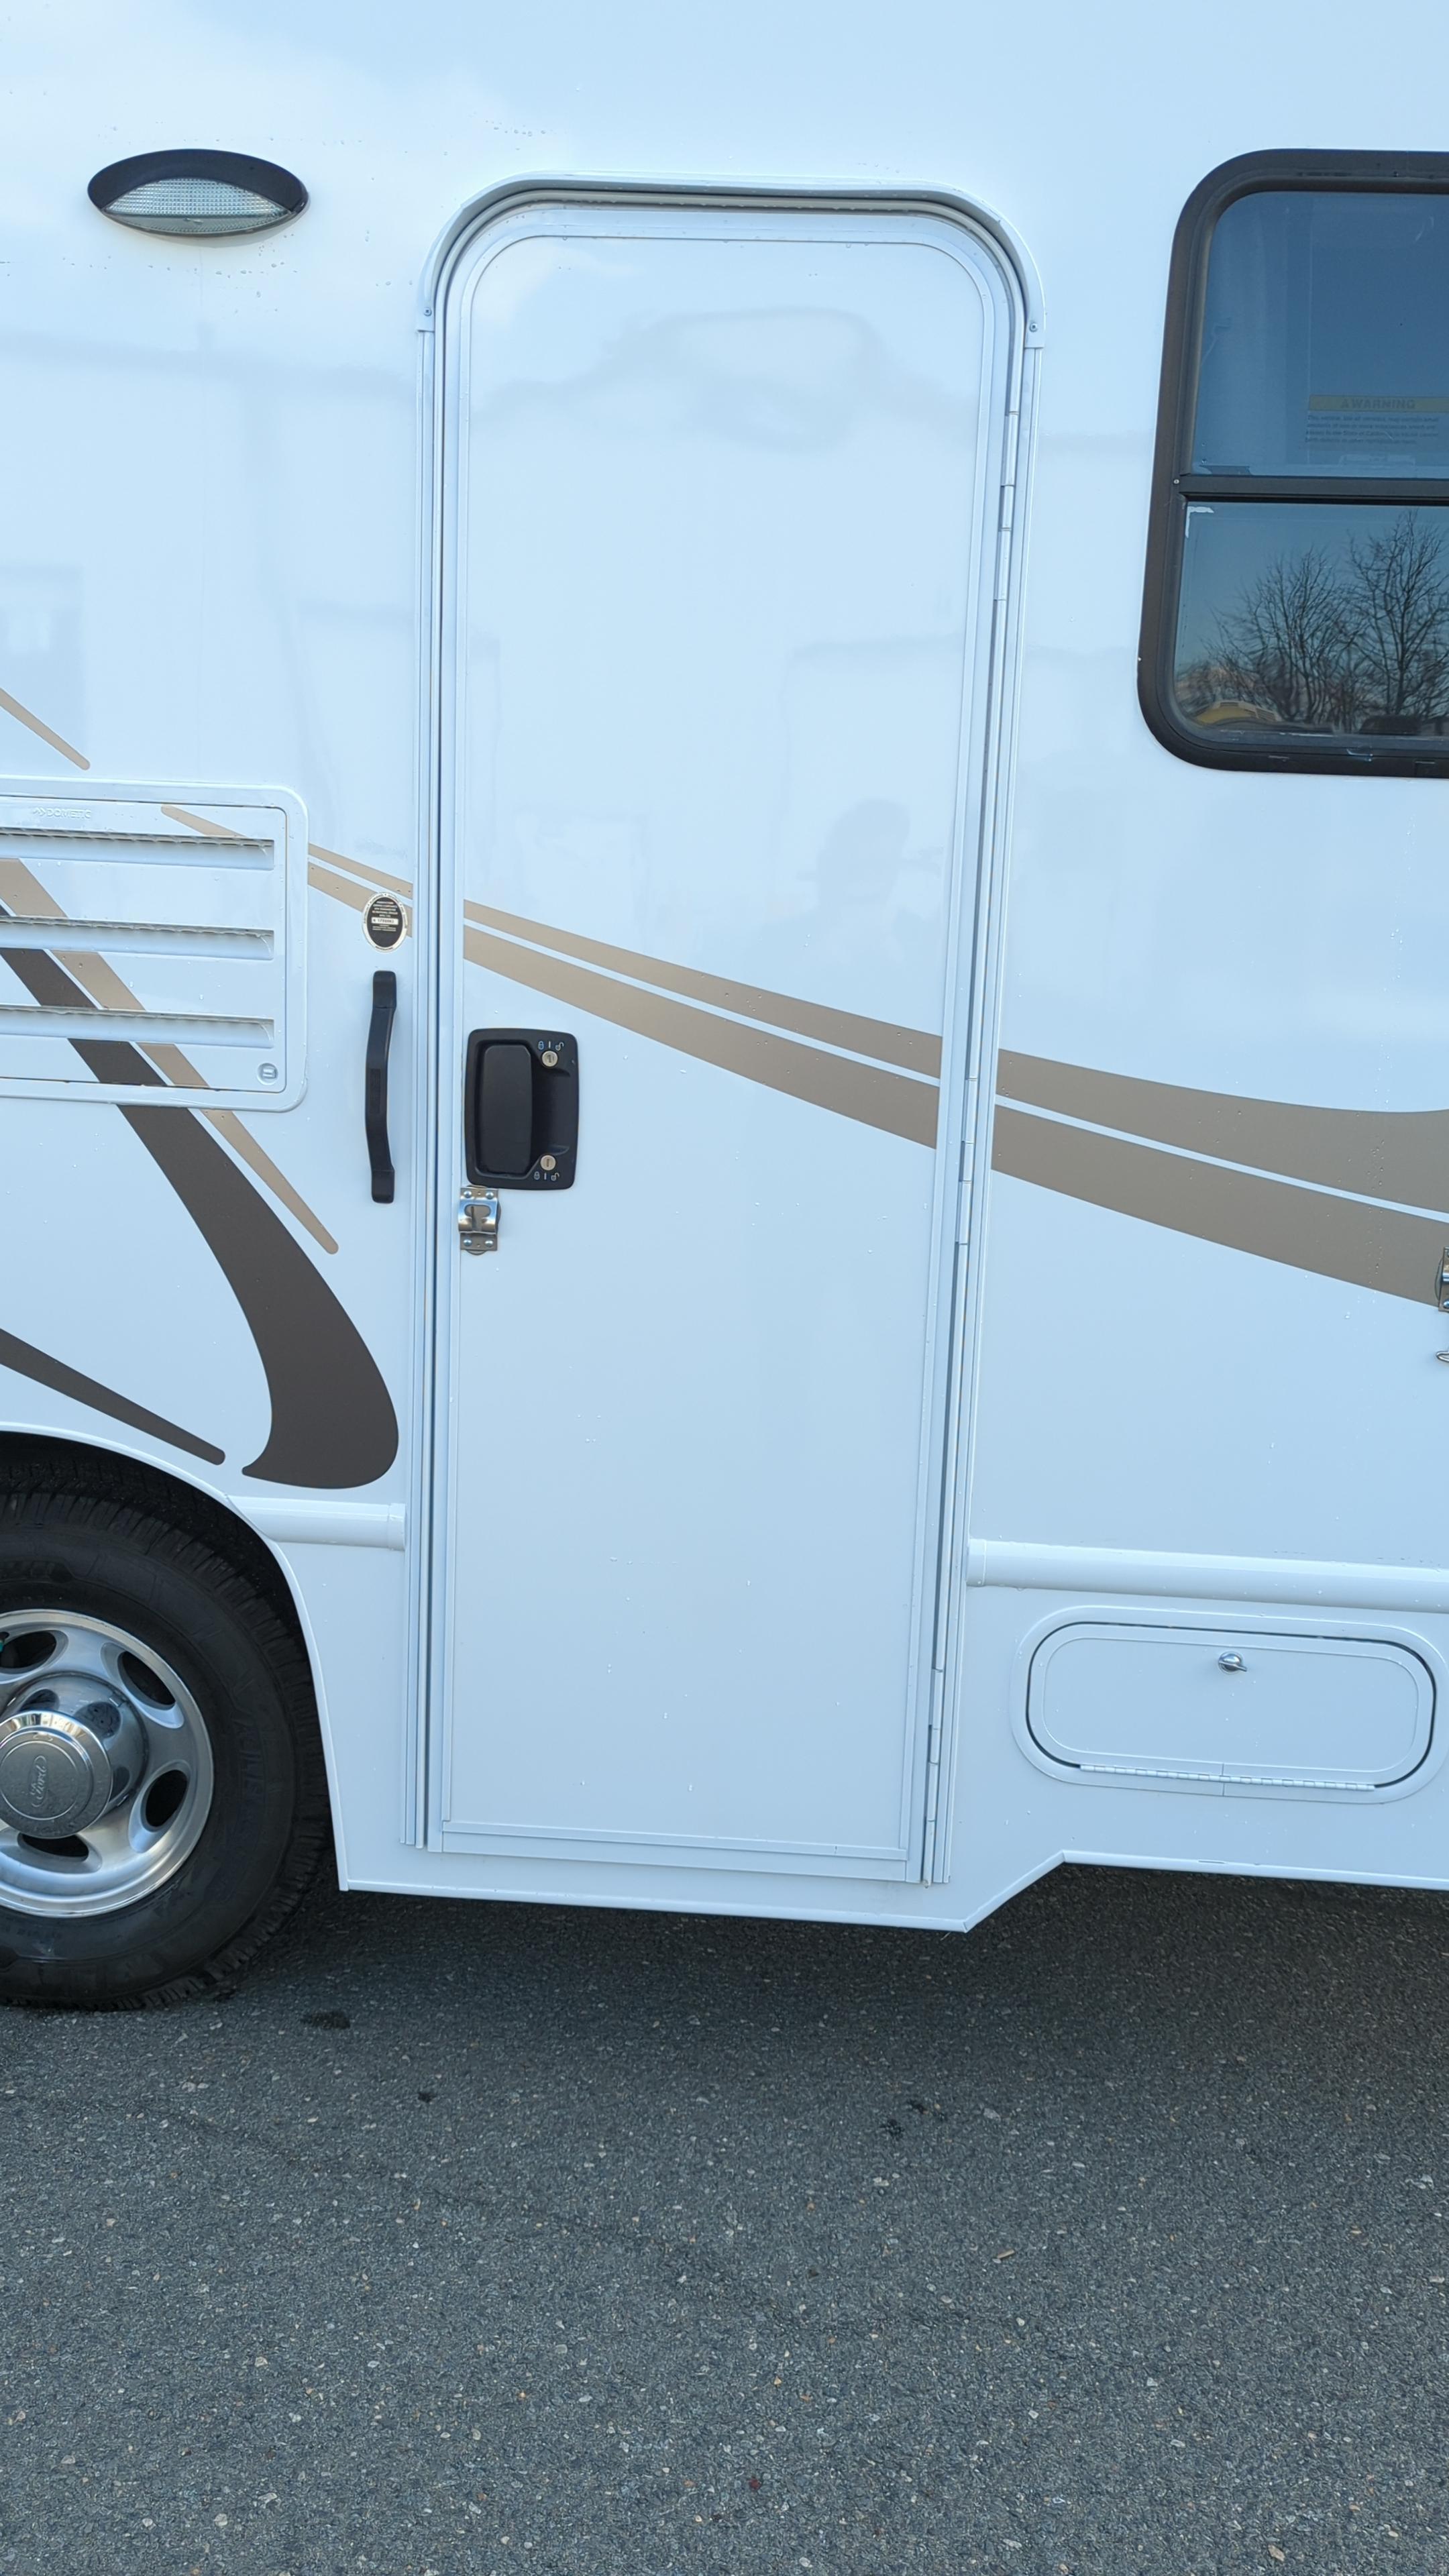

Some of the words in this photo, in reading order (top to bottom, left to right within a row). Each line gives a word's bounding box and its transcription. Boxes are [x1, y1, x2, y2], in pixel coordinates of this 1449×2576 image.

[1352, 398, 1415, 409] WARNING
[46, 808, 91, 818] DOMETIC
[30, 1764, 47, 1801] Ford
